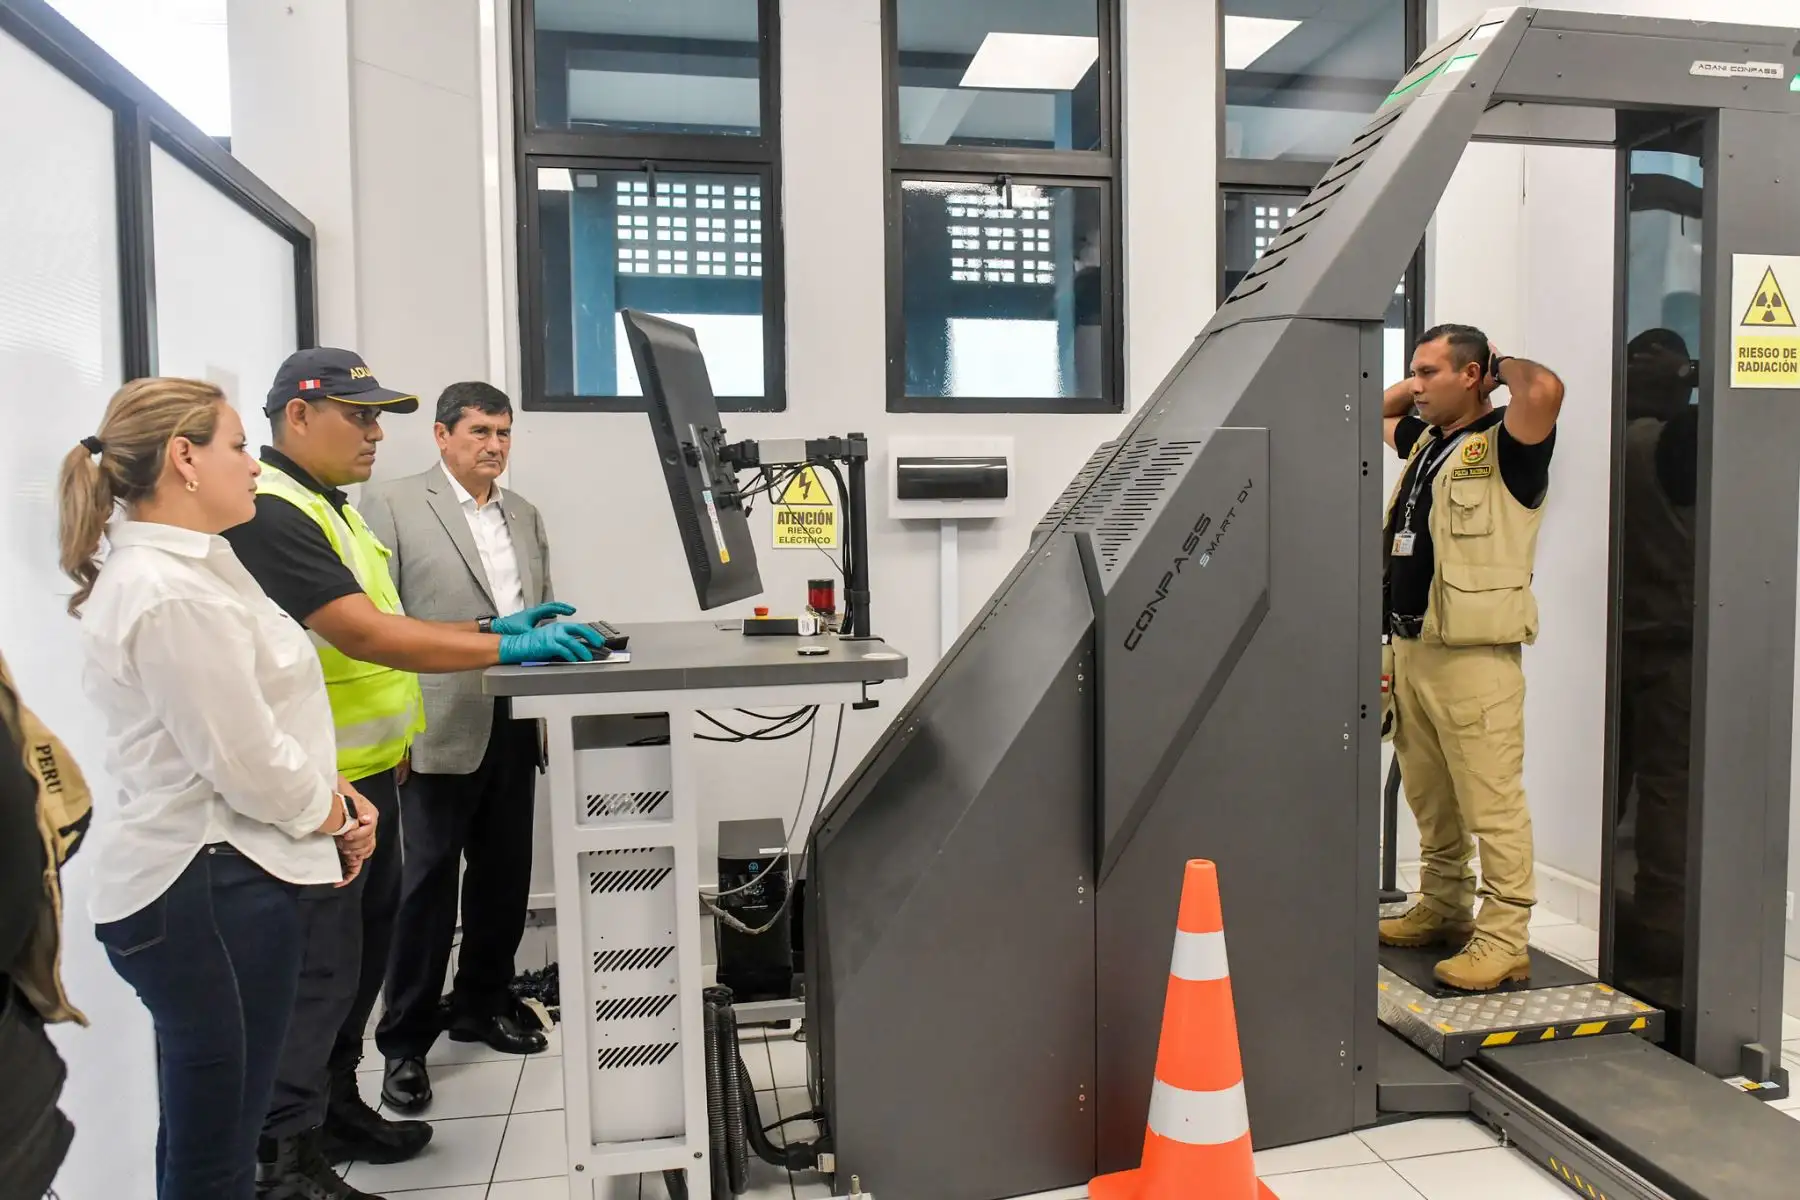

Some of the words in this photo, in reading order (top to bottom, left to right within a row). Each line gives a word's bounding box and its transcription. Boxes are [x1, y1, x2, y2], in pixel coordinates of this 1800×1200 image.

[1698, 63, 1728, 71] ADANI
[1738, 347, 1780, 359] RIESGO
[1783, 348, 1797, 359] DE
[1737, 359, 1798, 373] RADIACIÓN
[776, 509, 834, 526] ATENCIÓN
[787, 526, 823, 535] RIESGO
[1199, 507, 1236, 568] SMART
[1123, 512, 1213, 652] CONPASS
